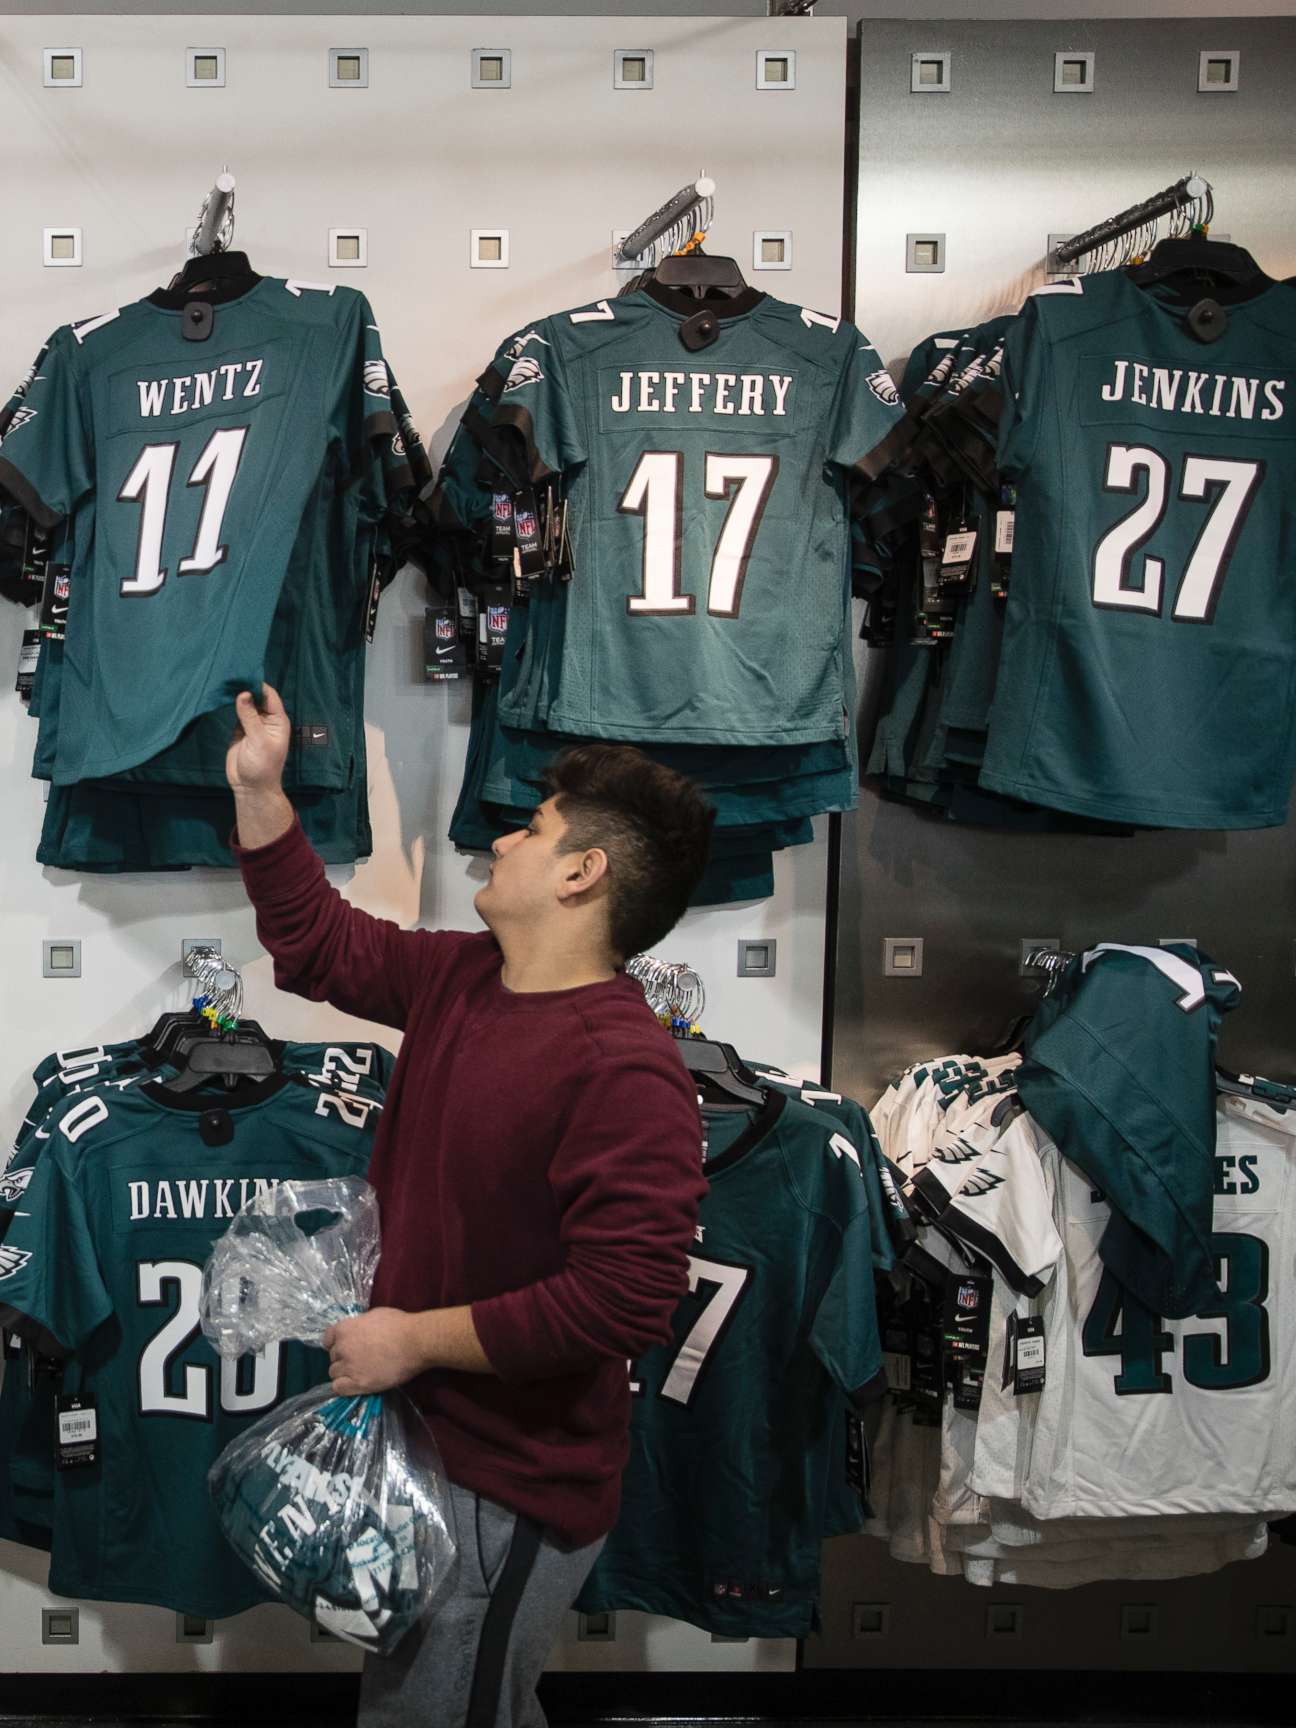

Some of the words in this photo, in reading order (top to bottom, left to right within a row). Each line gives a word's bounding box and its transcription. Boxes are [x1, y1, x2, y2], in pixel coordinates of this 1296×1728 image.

[136, 358, 263, 418] WENTZ
[610, 370, 793, 417] JEFFERY
[1101, 359, 1286, 422] JENKINS
[116, 423, 253, 600] 11
[615, 449, 780, 620] 17
[1091, 440, 1268, 626] 27
[128, 1177, 292, 1221] DAWKIN
[1081, 1232, 1272, 1397] 43
